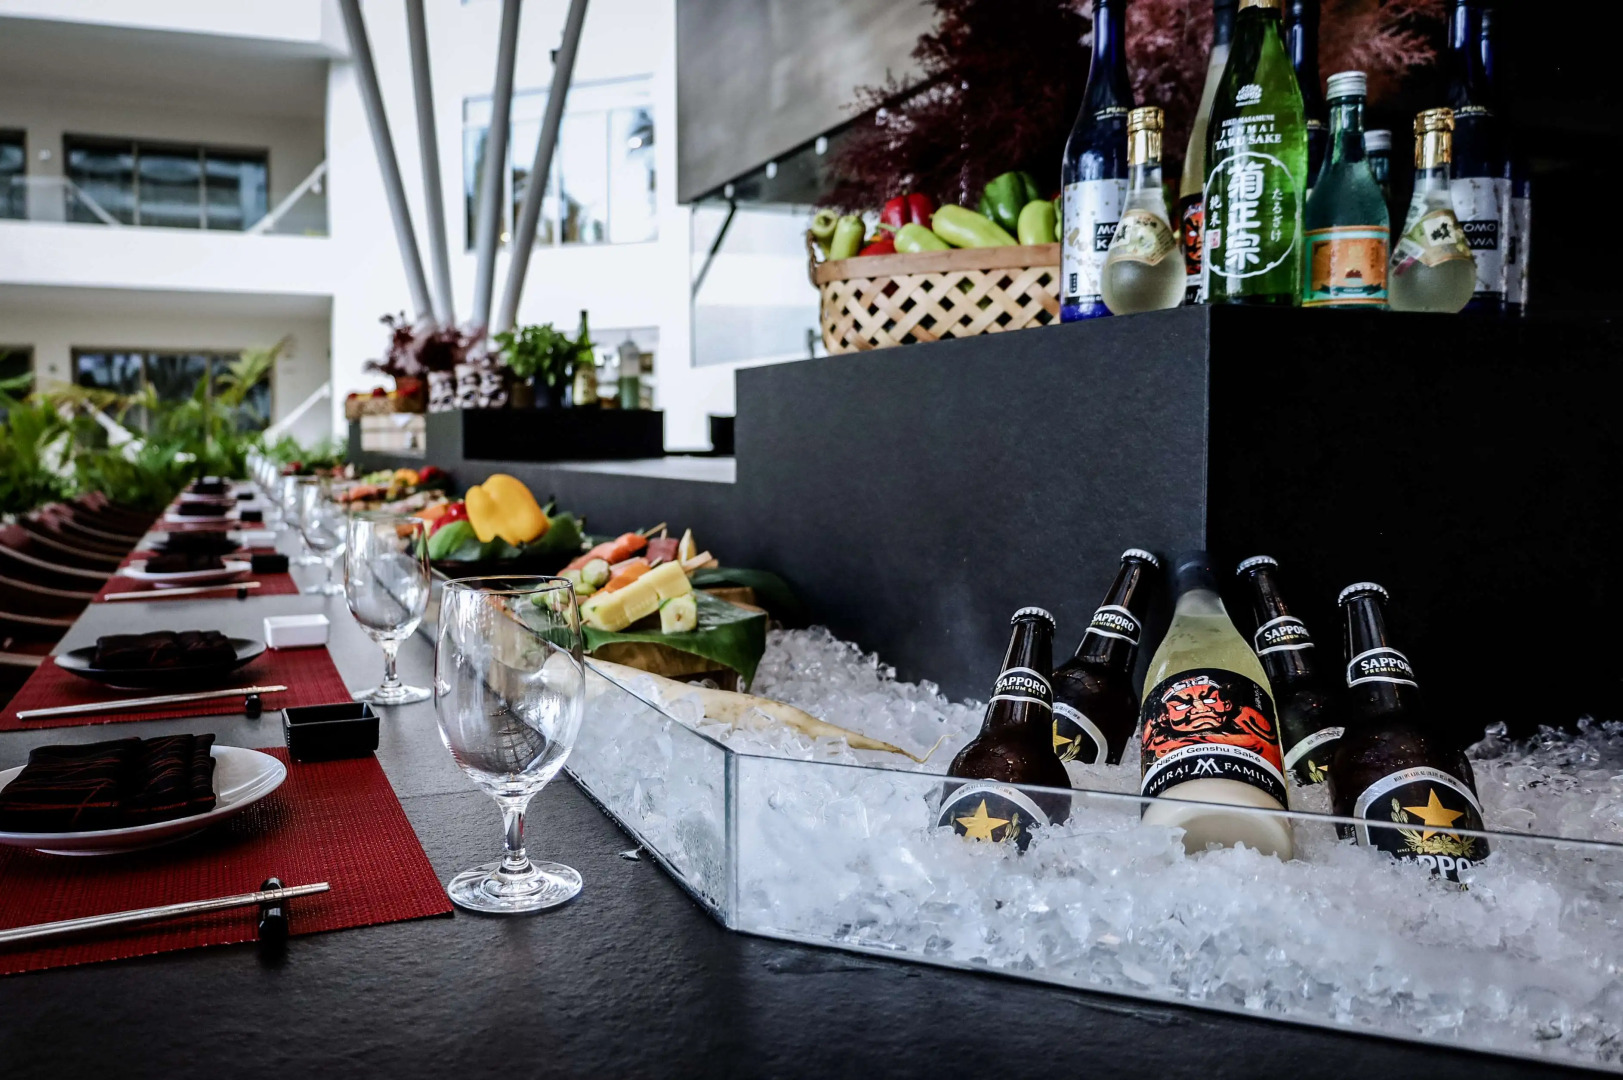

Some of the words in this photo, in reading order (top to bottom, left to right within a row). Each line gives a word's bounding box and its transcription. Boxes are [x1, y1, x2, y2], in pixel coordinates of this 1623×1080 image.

[1220, 124, 1275, 139] JUNMAI
[1215, 136, 1246, 150] TARU
[1248, 134, 1282, 145] SAKE
[1225, 161, 1265, 270] 菊正宗
[1463, 223, 1496, 232] OMO
[1091, 613, 1135, 632] SAPPORO
[1364, 667, 1402, 675] PREMIUM
[996, 676, 1047, 695] SAPPORO
[1156, 749, 1183, 769] Nigori
[1186, 745, 1230, 754] Genshu
[1149, 764, 1189, 795] MURAI
[1224, 762, 1274, 788] FAMILY
